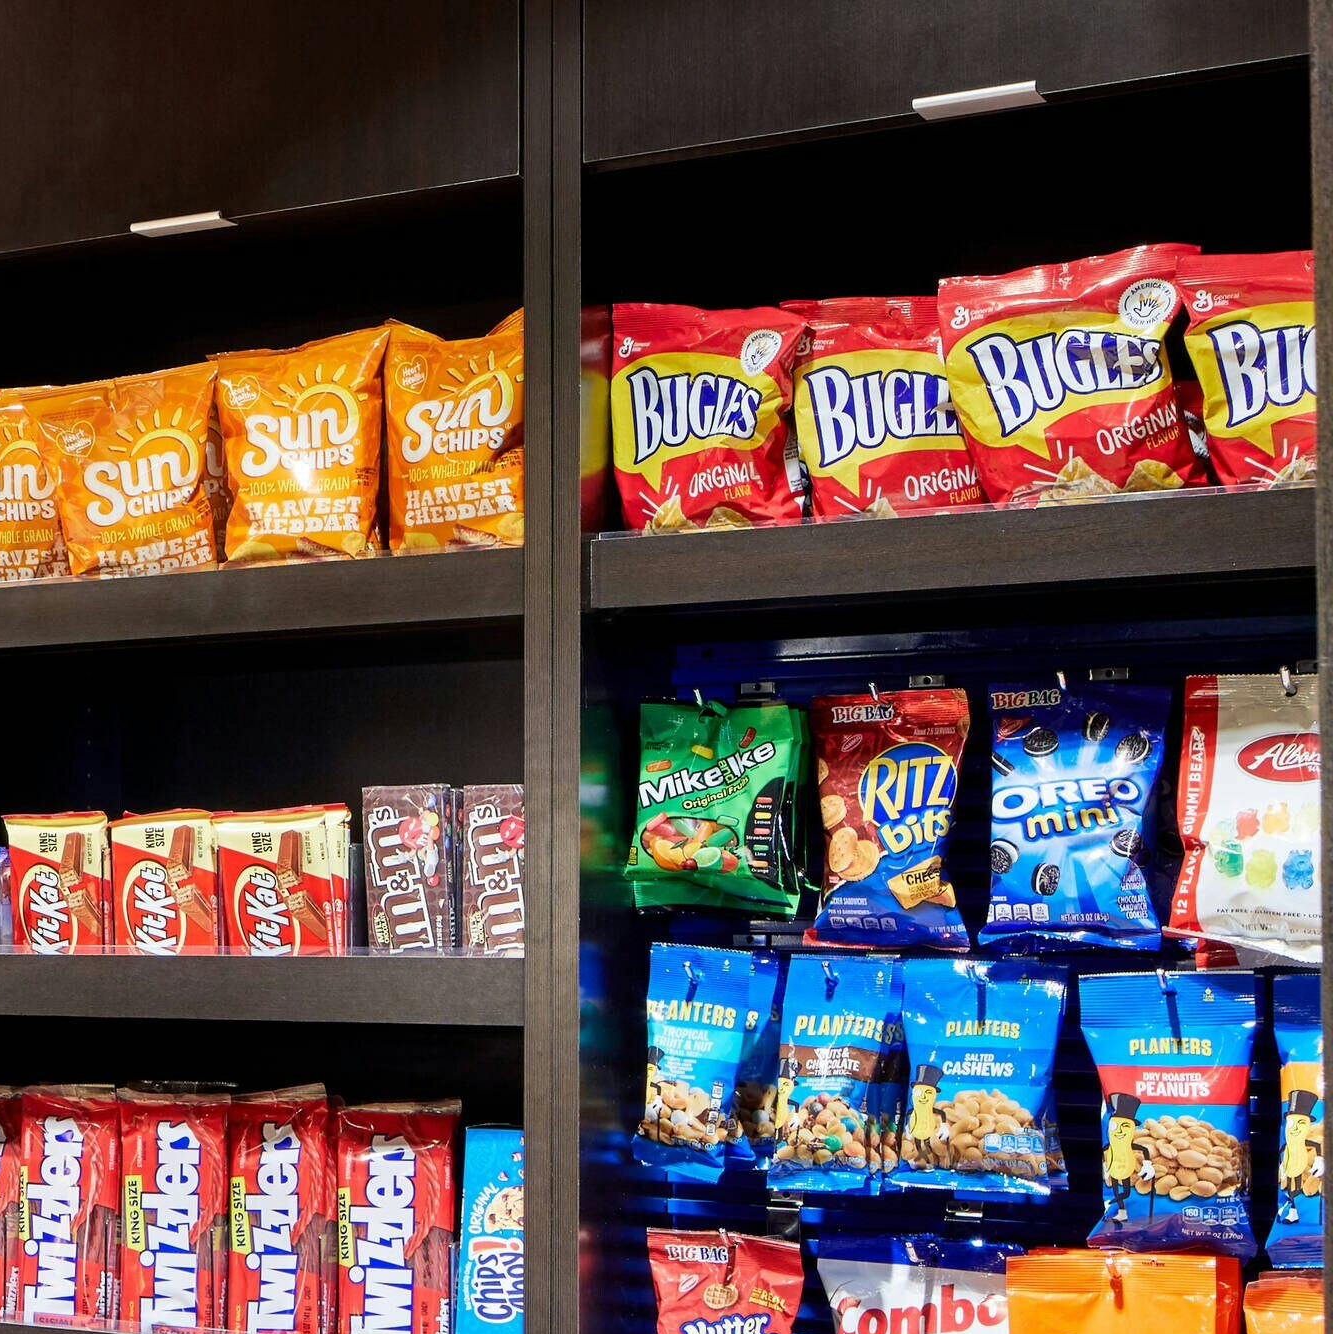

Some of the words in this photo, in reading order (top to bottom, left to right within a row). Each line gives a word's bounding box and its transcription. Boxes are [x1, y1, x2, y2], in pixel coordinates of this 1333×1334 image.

[966, 329, 1163, 438] BUGLES
[402, 388, 513, 463] Sun
[627, 366, 762, 465] BUGLES
[803, 365, 963, 468] BUGLE
[241, 408, 359, 477] Sun
[433, 427, 505, 454] CHIPS
[1146, 426, 1180, 450] FLAVOR
[84, 451, 199, 526] Sun
[406, 477, 512, 509] HARVEST
[904, 465, 980, 501] ORIGINA
[245, 496, 361, 520] HARVEST
[404, 494, 517, 527] CHEDDAR
[248, 513, 360, 536] CHEDDAR
[98, 529, 209, 567] HARVEST
[992, 690, 1026, 709] BIG
[1026, 688, 1060, 706] BAG
[832, 706, 862, 723] BIG
[864, 705, 894, 721] BAG
[639, 766, 723, 808] Mike
[727, 742, 776, 780] Ike
[863, 755, 953, 821] RITZ
[683, 789, 727, 810] Original
[991, 779, 1139, 820] OREO
[1182, 781, 1201, 834] GUMMI
[880, 809, 951, 854] bits
[1026, 801, 1119, 840] mini
[39, 832, 48, 853] KING
[48, 832, 57, 852] SIZE
[146, 827, 154, 848] KING
[155, 827, 164, 847] SIZE
[263, 832, 271, 852] SIZE
[1176, 899, 1188, 915] 12
[794, 1014, 884, 1043] PLANTERS
[945, 1019, 1021, 1040] PLANTERS
[964, 1053, 995, 1063] SALTED
[1129, 1037, 1213, 1057] PLANTERS
[805, 1058, 861, 1073] CHOCOLATE
[943, 1061, 1015, 1078] CASHEWS
[1142, 1072, 1161, 1082] DRY
[1162, 1072, 1202, 1082] ROASTED
[1135, 1080, 1210, 1097] PEANUTS
[129, 1180, 137, 1208] SIZE
[232, 1181, 241, 1208] SIZE
[337, 1192, 346, 1222] SIZE
[468, 1182, 499, 1234] ORIGINAL
[131, 1211, 140, 1244] KING
[236, 1211, 245, 1247] KING
[340, 1224, 350, 1260] KING
[666, 1245, 697, 1261] BIG
[699, 1246, 728, 1263] BAG
[473, 1254, 508, 1320] Chips
